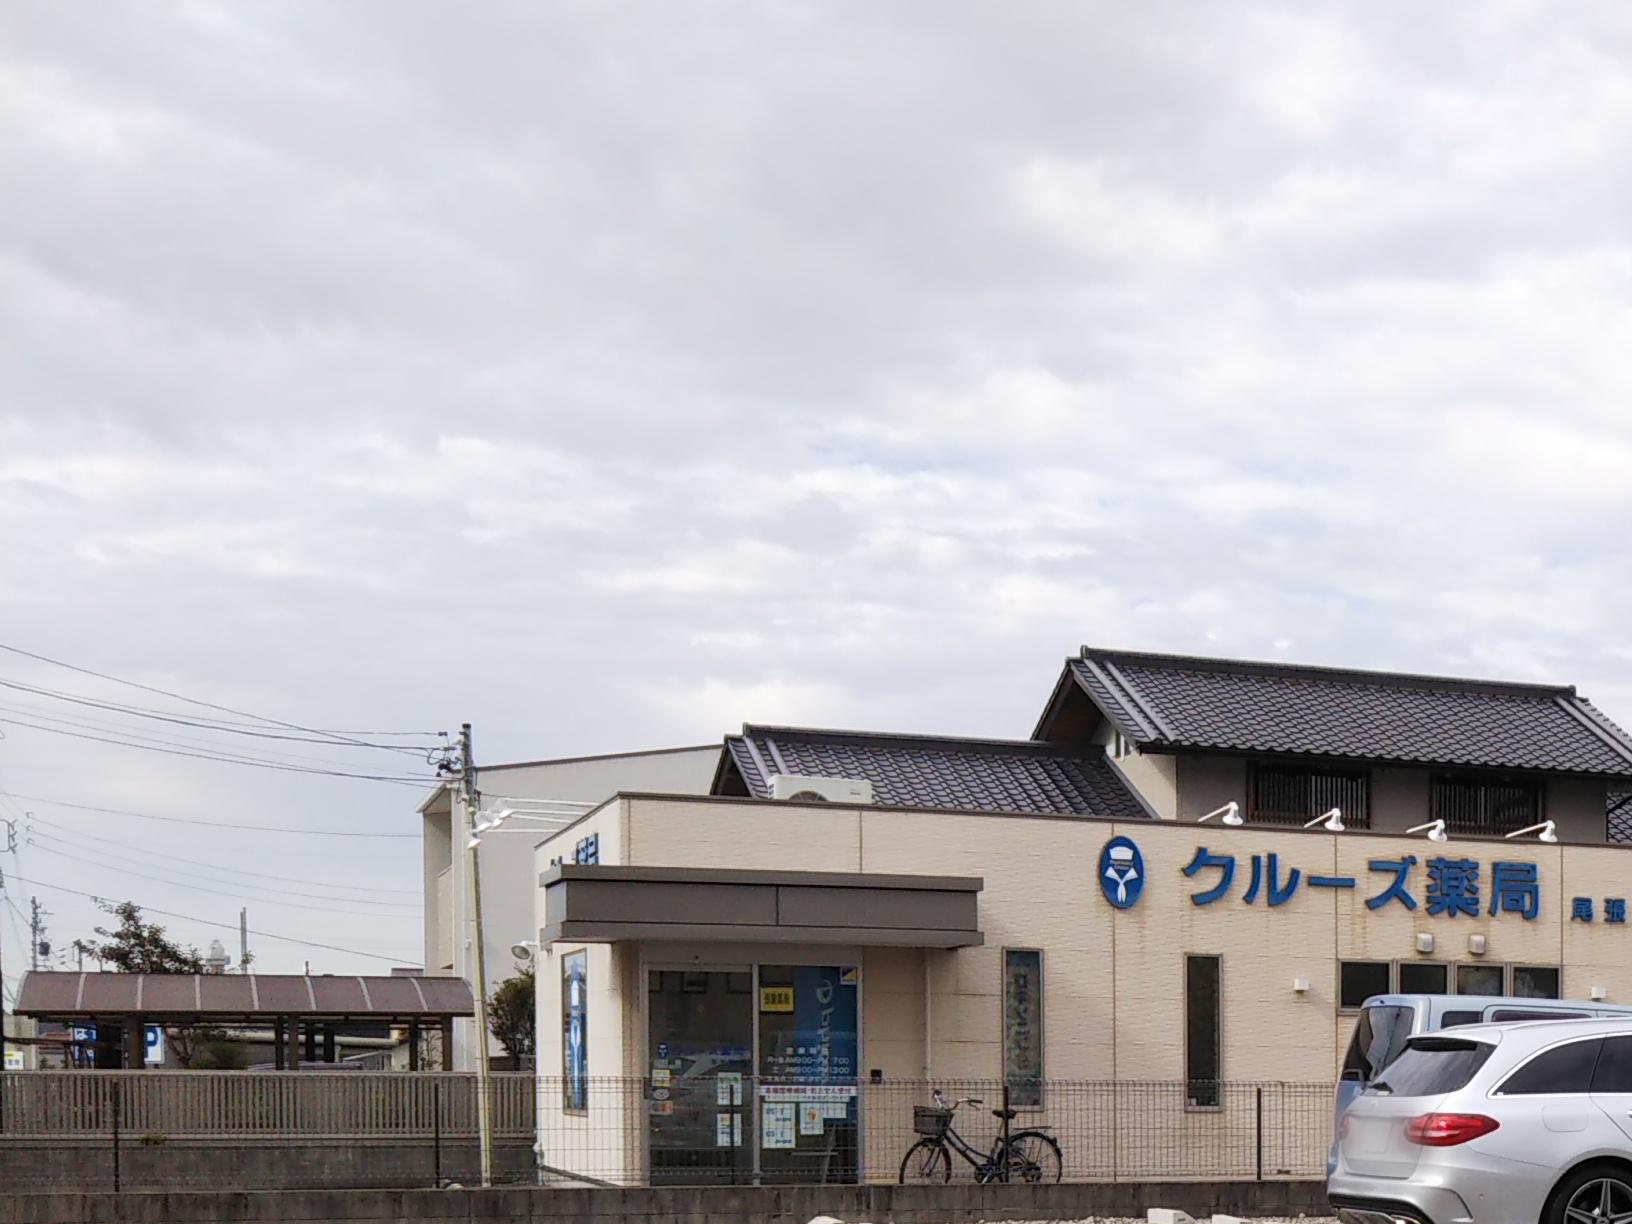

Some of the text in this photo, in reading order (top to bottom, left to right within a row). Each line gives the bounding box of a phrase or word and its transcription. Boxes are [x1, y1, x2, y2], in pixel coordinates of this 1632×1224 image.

[1181, 846, 1540, 921] クルーズ薬局
